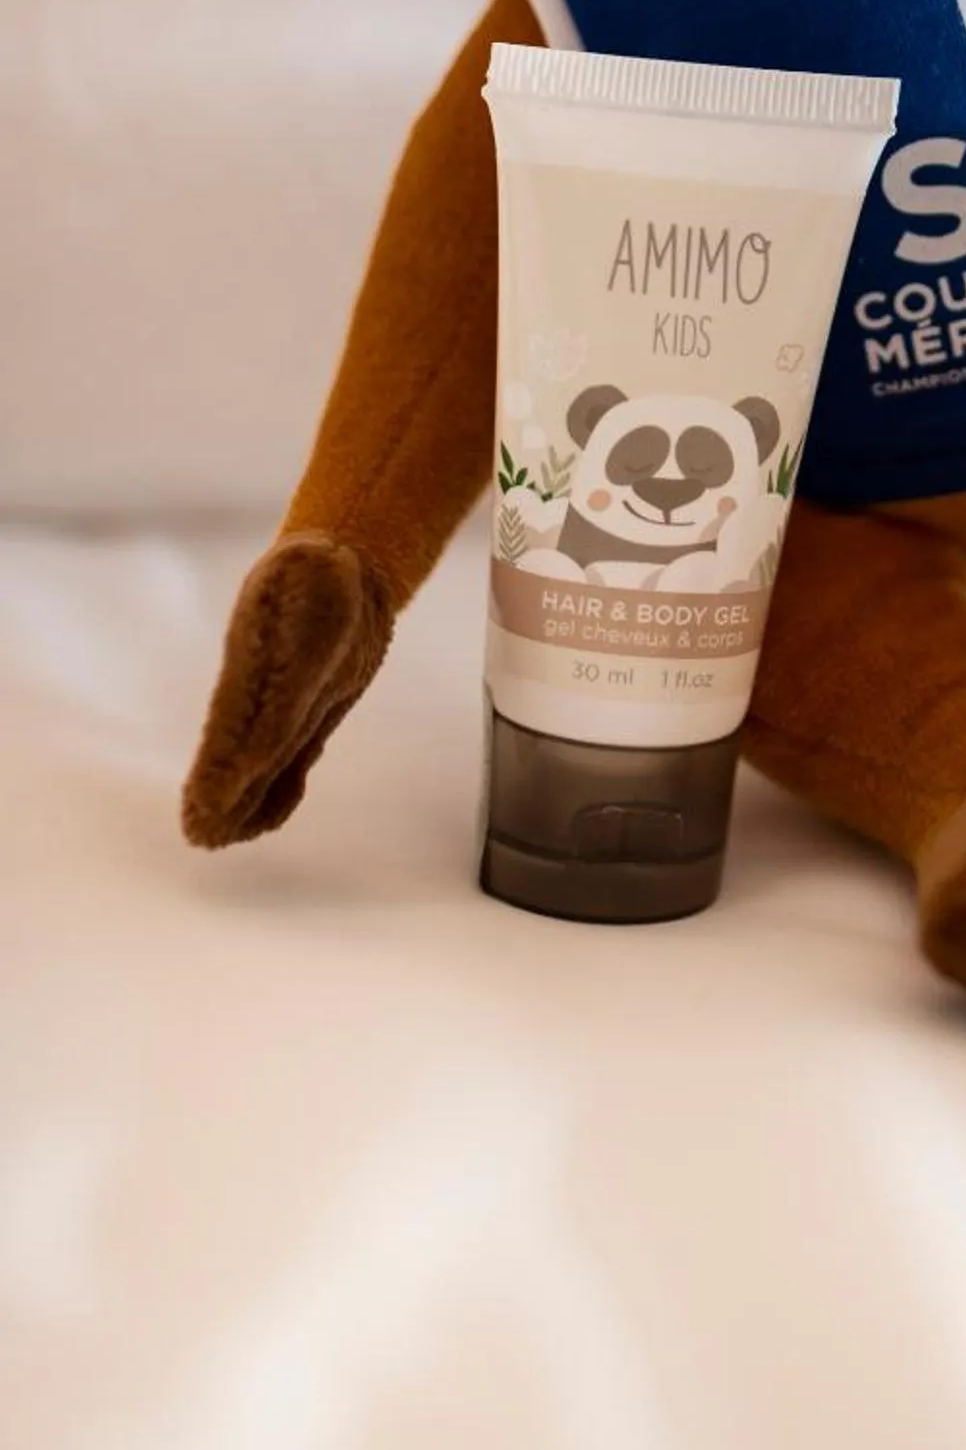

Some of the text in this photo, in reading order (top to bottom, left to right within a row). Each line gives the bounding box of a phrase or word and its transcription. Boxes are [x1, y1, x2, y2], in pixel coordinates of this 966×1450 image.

[607, 219, 771, 305] AMIMO
[652, 312, 713, 359] KIDS
[541, 590, 751, 626] HAIR & BODY GEL
[542, 618, 744, 649] gel cheveux & corps
[572, 660, 600, 683] 30
[607, 666, 634, 686] ml
